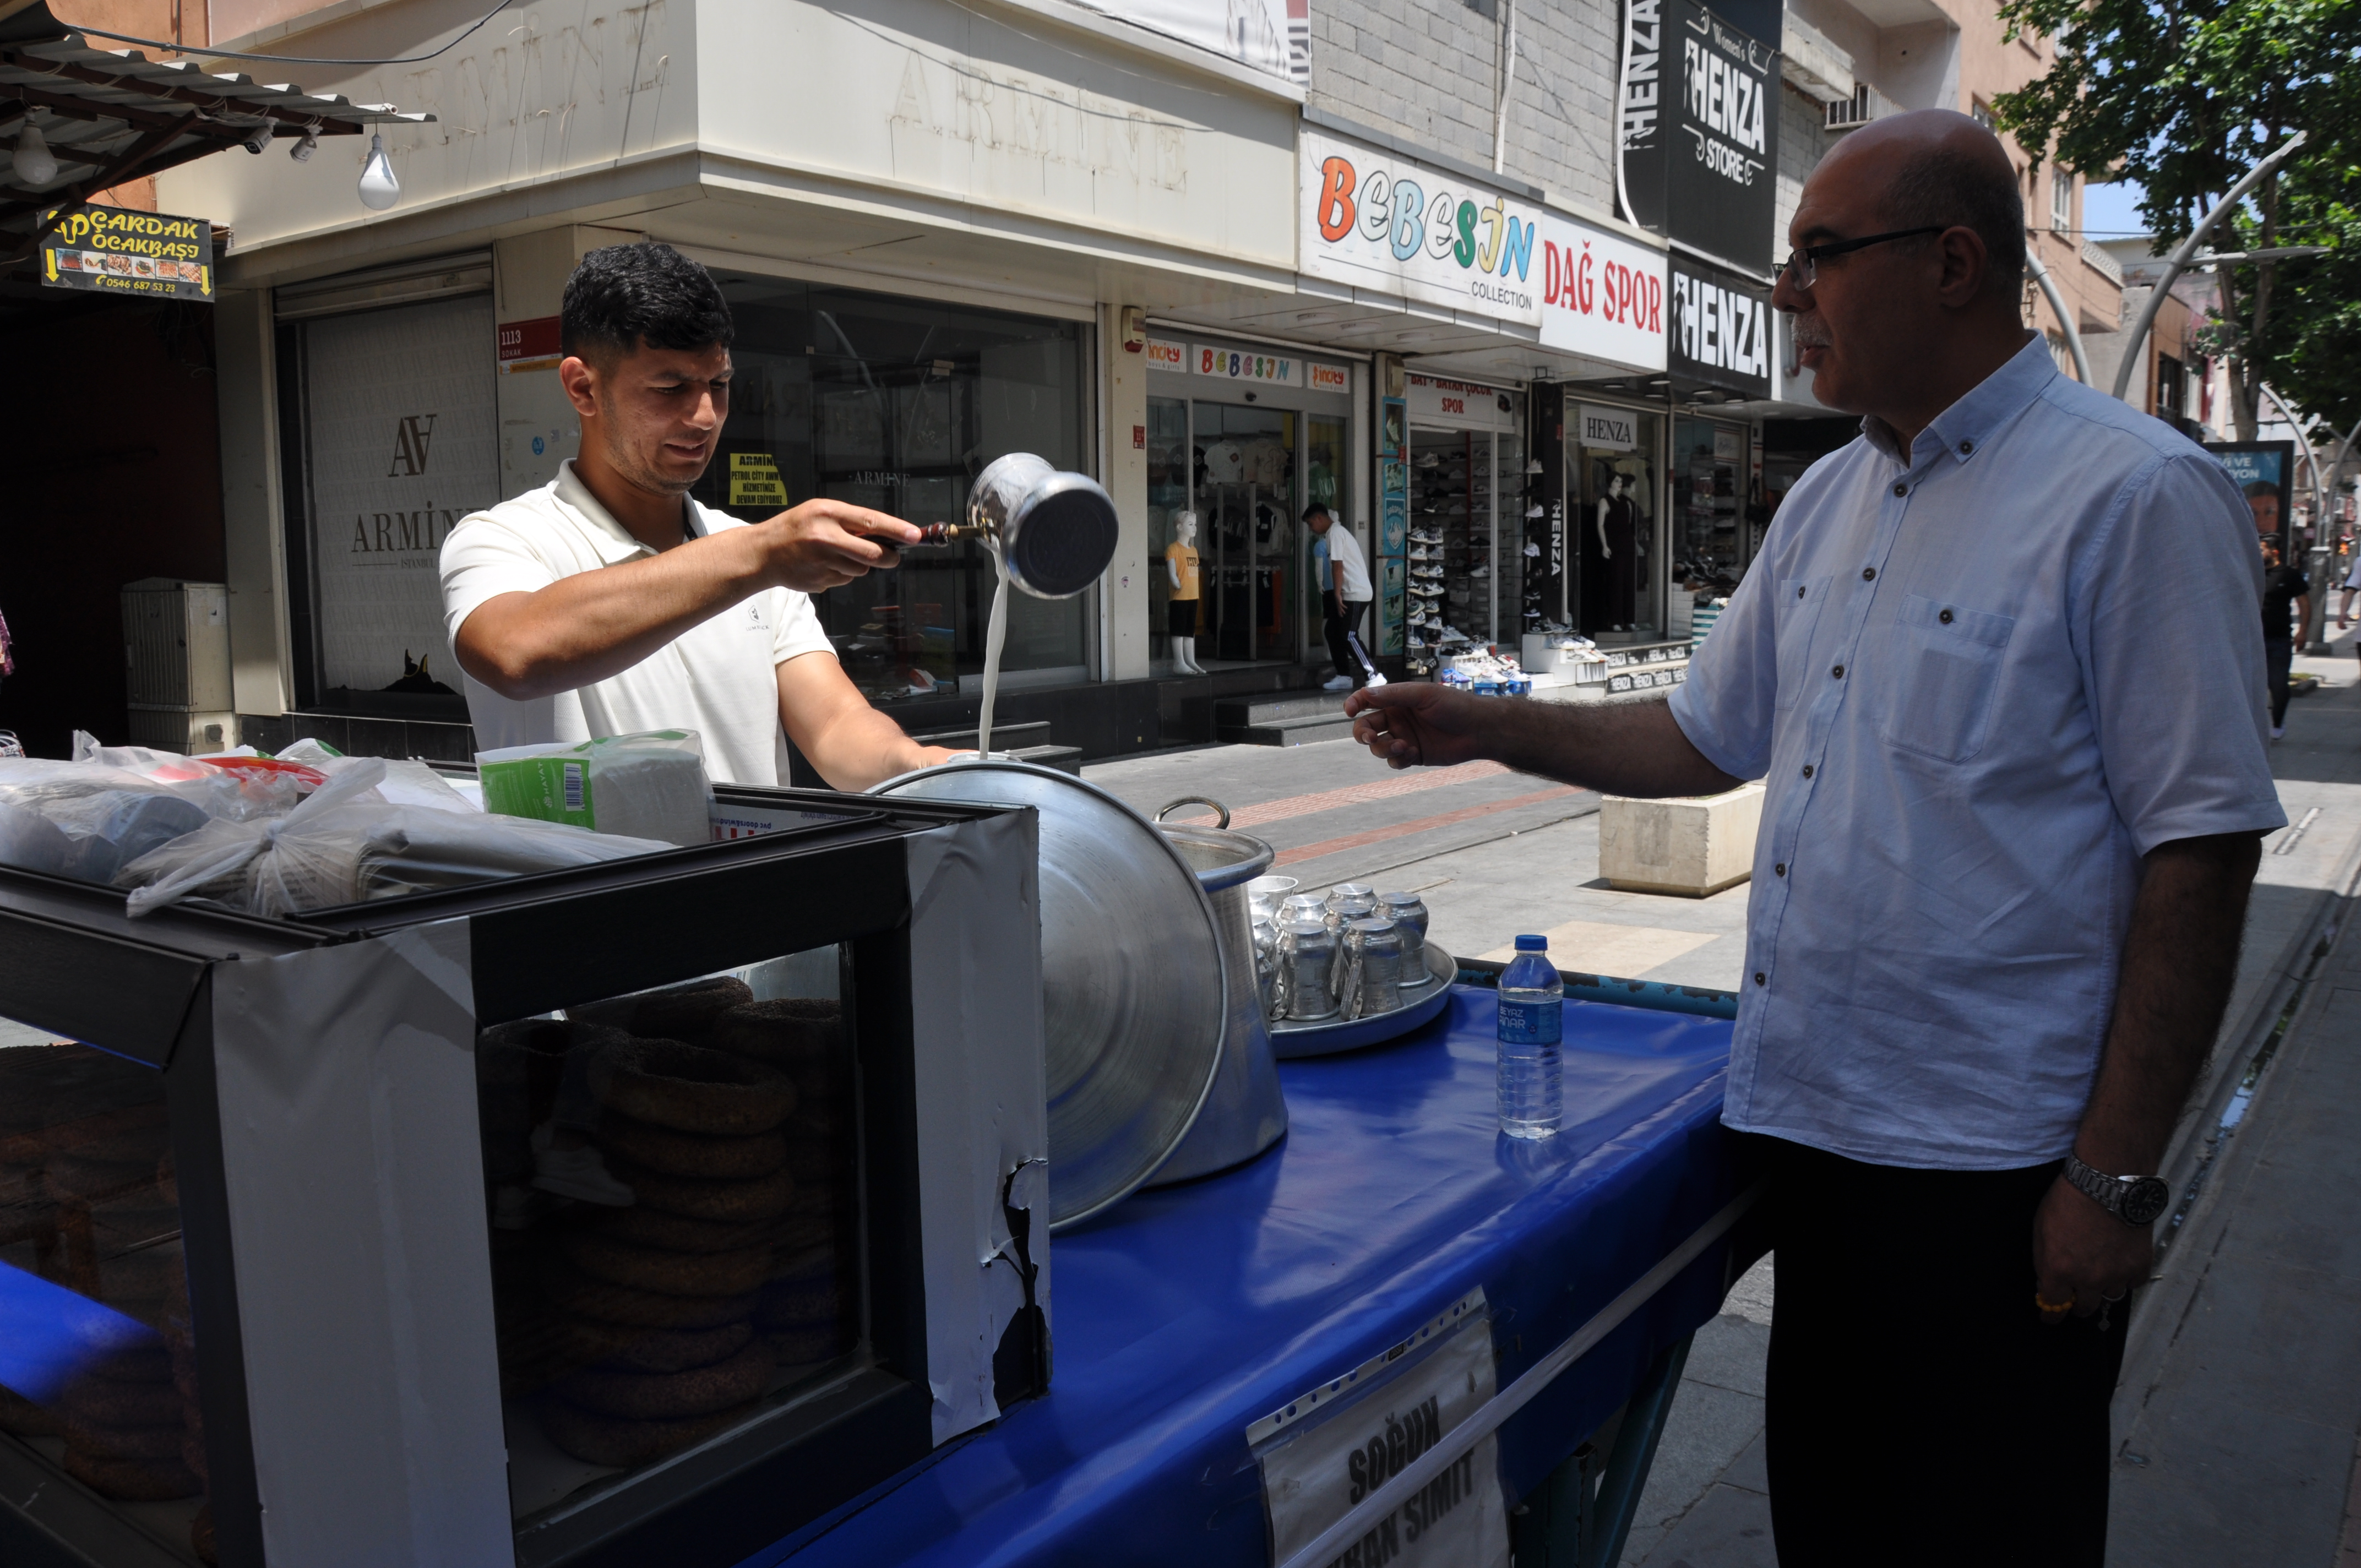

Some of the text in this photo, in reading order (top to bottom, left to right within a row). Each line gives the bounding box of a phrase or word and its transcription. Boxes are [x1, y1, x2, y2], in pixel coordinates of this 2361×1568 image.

[1713, 23, 1745, 61] Women's
[1684, 37, 1765, 155] HENZA
[1706, 138, 1744, 184] STORE
[90, 211, 198, 239] ÇARDAK
[92, 234, 199, 261] OCAKBAŞI
[106, 278, 176, 293] 0546 687 53 23
[1472, 281, 1532, 311] COLLECTION
[1544, 239, 1662, 334] DAĞ SPOR
[502, 330, 521, 346] 1113
[1672, 271, 1768, 379] HENZA
[502, 349, 521, 358] SOKAK
[1441, 397, 1464, 413] SPOR
[1587, 417, 1631, 443] HENZA
[739, 454, 774, 467] ARMİN
[731, 471, 750, 481] PETROL
[752, 470, 764, 481] CİTY
[2227, 469, 2260, 479] YON
[736, 494, 782, 505] DEVAM EDİYORUZ
[743, 482, 776, 493] HİZMETİNİZE
[351, 500, 486, 552] ARMİN
[538, 762, 550, 794] HAYAT
[1500, 1006, 1524, 1018] BEYAZ
[1348, 1395, 1441, 1505] SOĞUK
